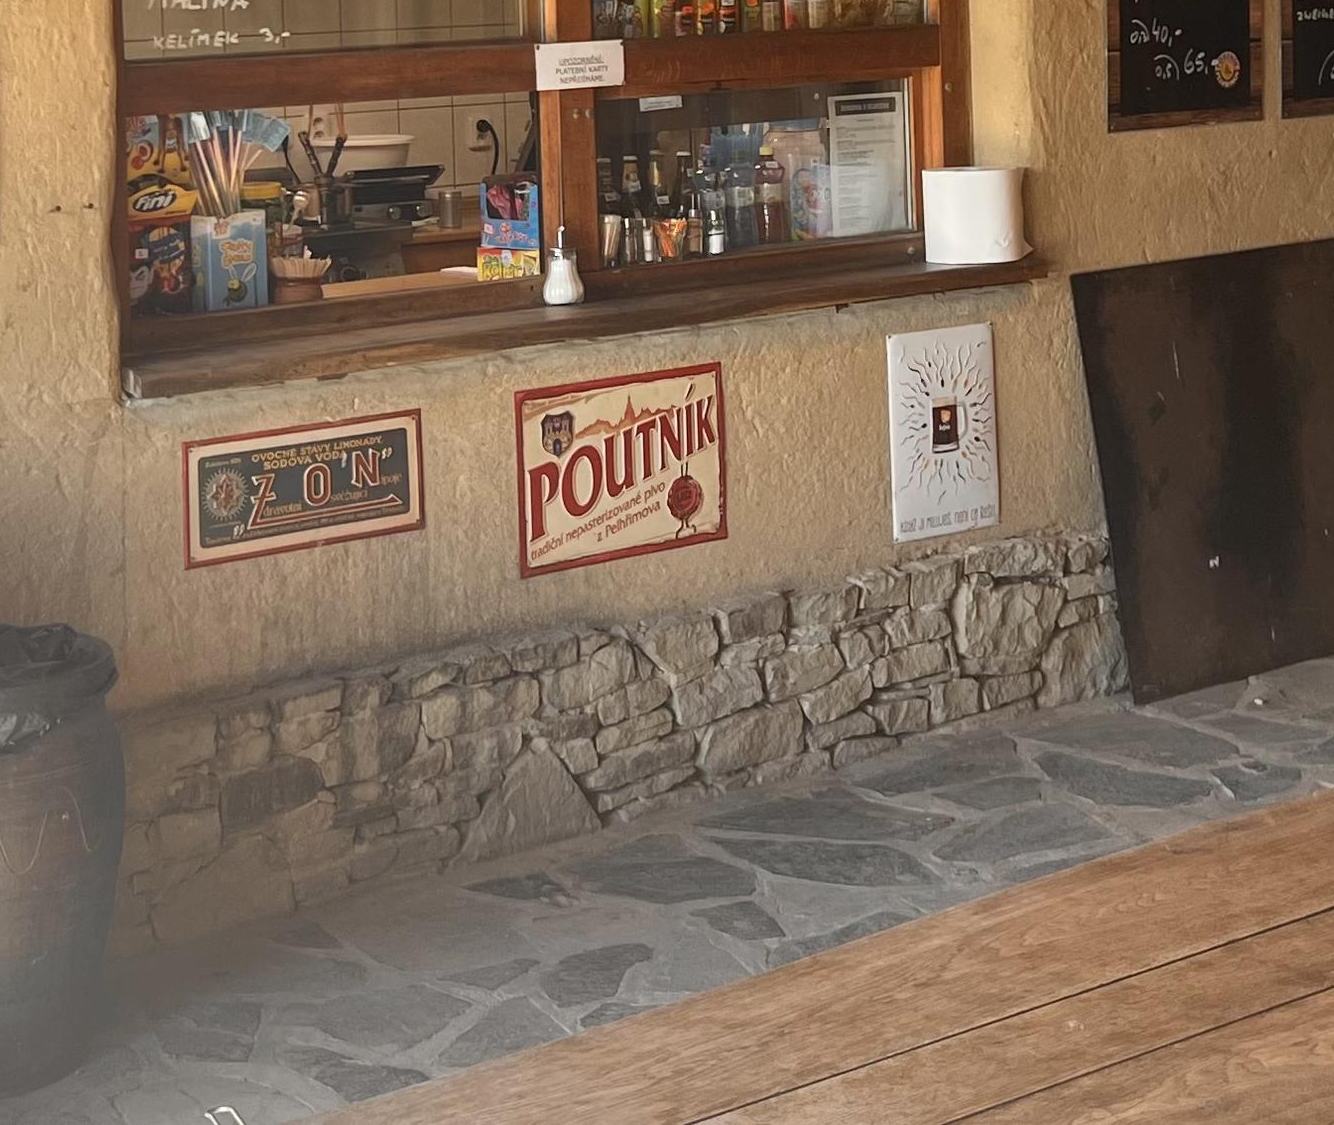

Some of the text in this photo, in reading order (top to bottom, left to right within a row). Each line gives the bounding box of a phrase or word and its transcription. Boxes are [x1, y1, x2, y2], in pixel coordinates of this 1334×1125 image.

[153, 28, 240, 50] KELÍMEK
[251, 446, 297, 464] OVOCNÉ
[528, 384, 716, 543] POUTNÍK
[531, 532, 565, 561] tradiční
[565, 492, 642, 543] nepasterizované
[644, 481, 666, 505] pivo
[605, 500, 661, 538] Pelhřimova
